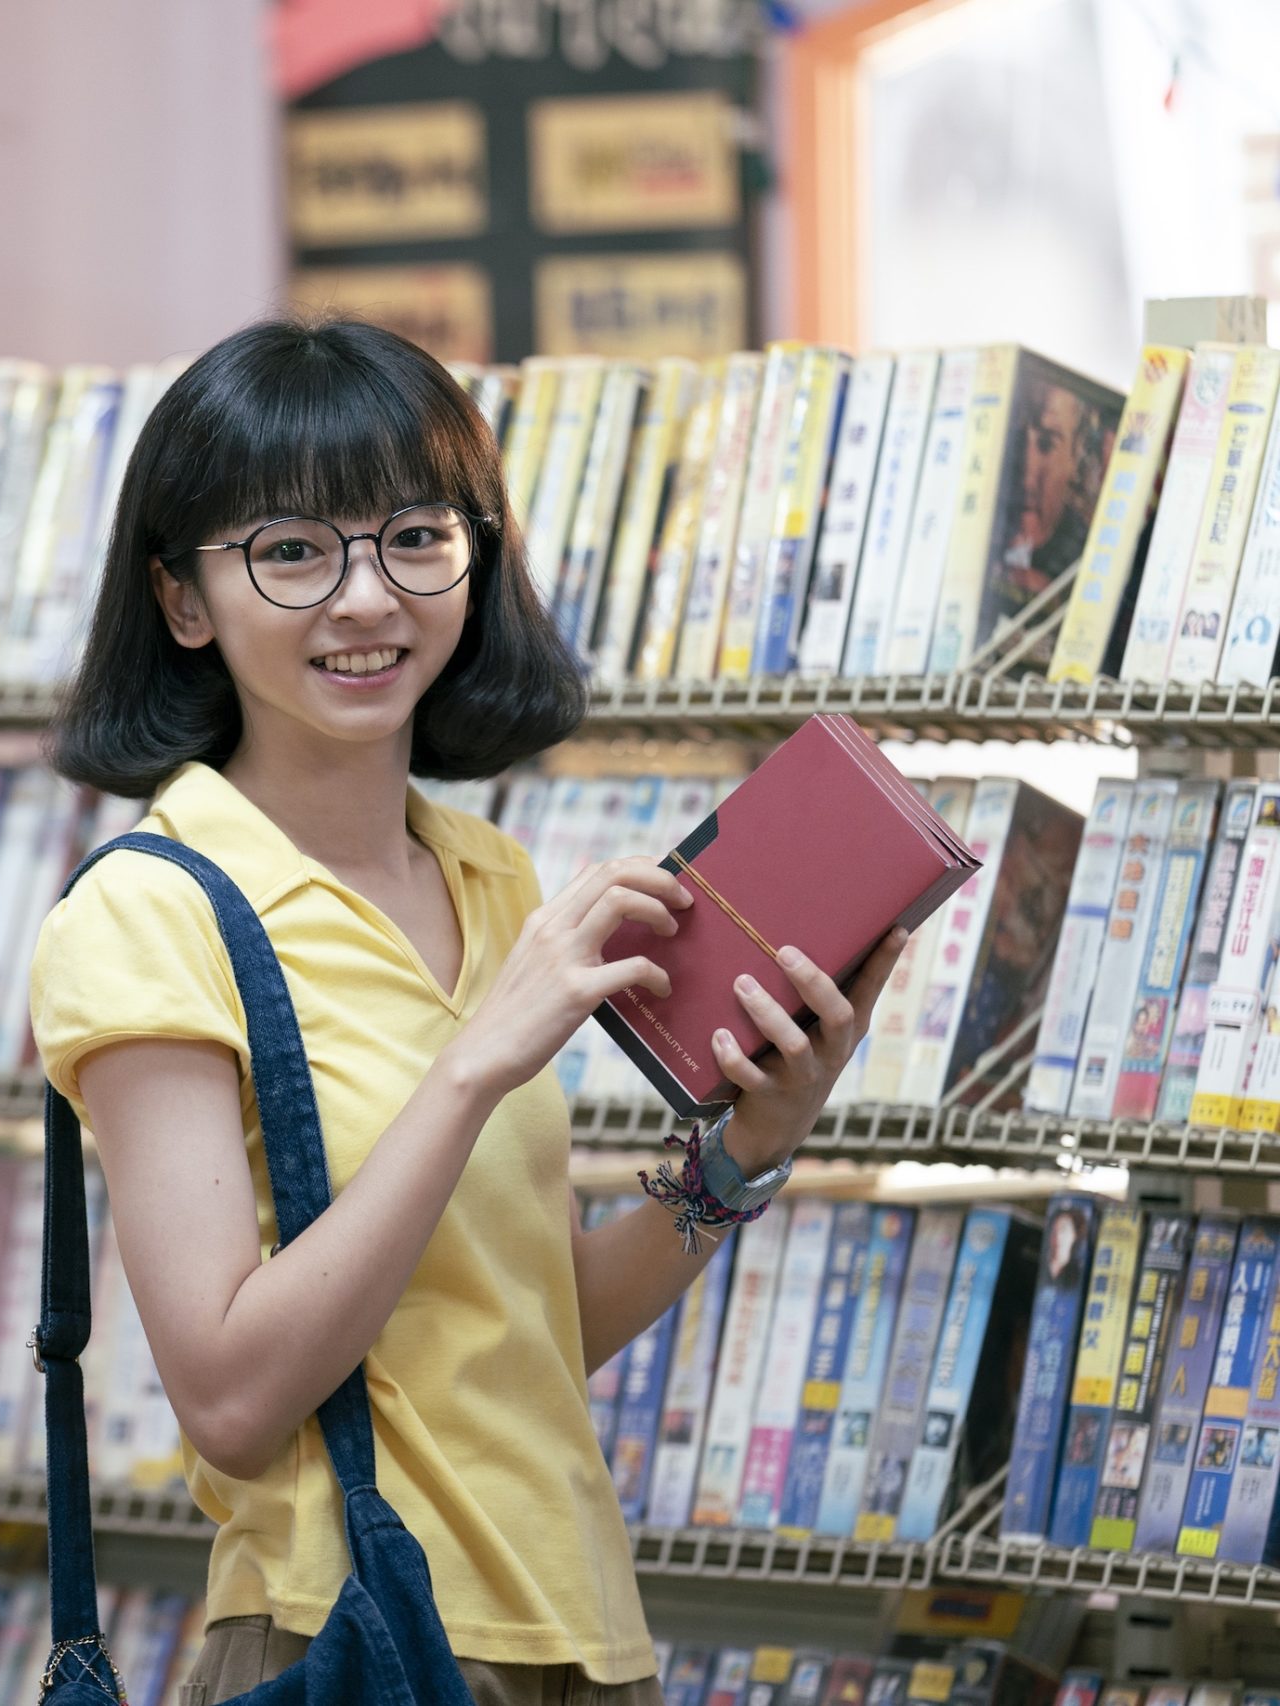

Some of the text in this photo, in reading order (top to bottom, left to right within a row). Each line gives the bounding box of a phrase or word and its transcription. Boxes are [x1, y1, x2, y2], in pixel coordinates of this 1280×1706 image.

[638, 1003, 657, 1024] HIGH
[654, 1022, 683, 1053] QUALITY
[681, 1051, 701, 1073] TAPE
